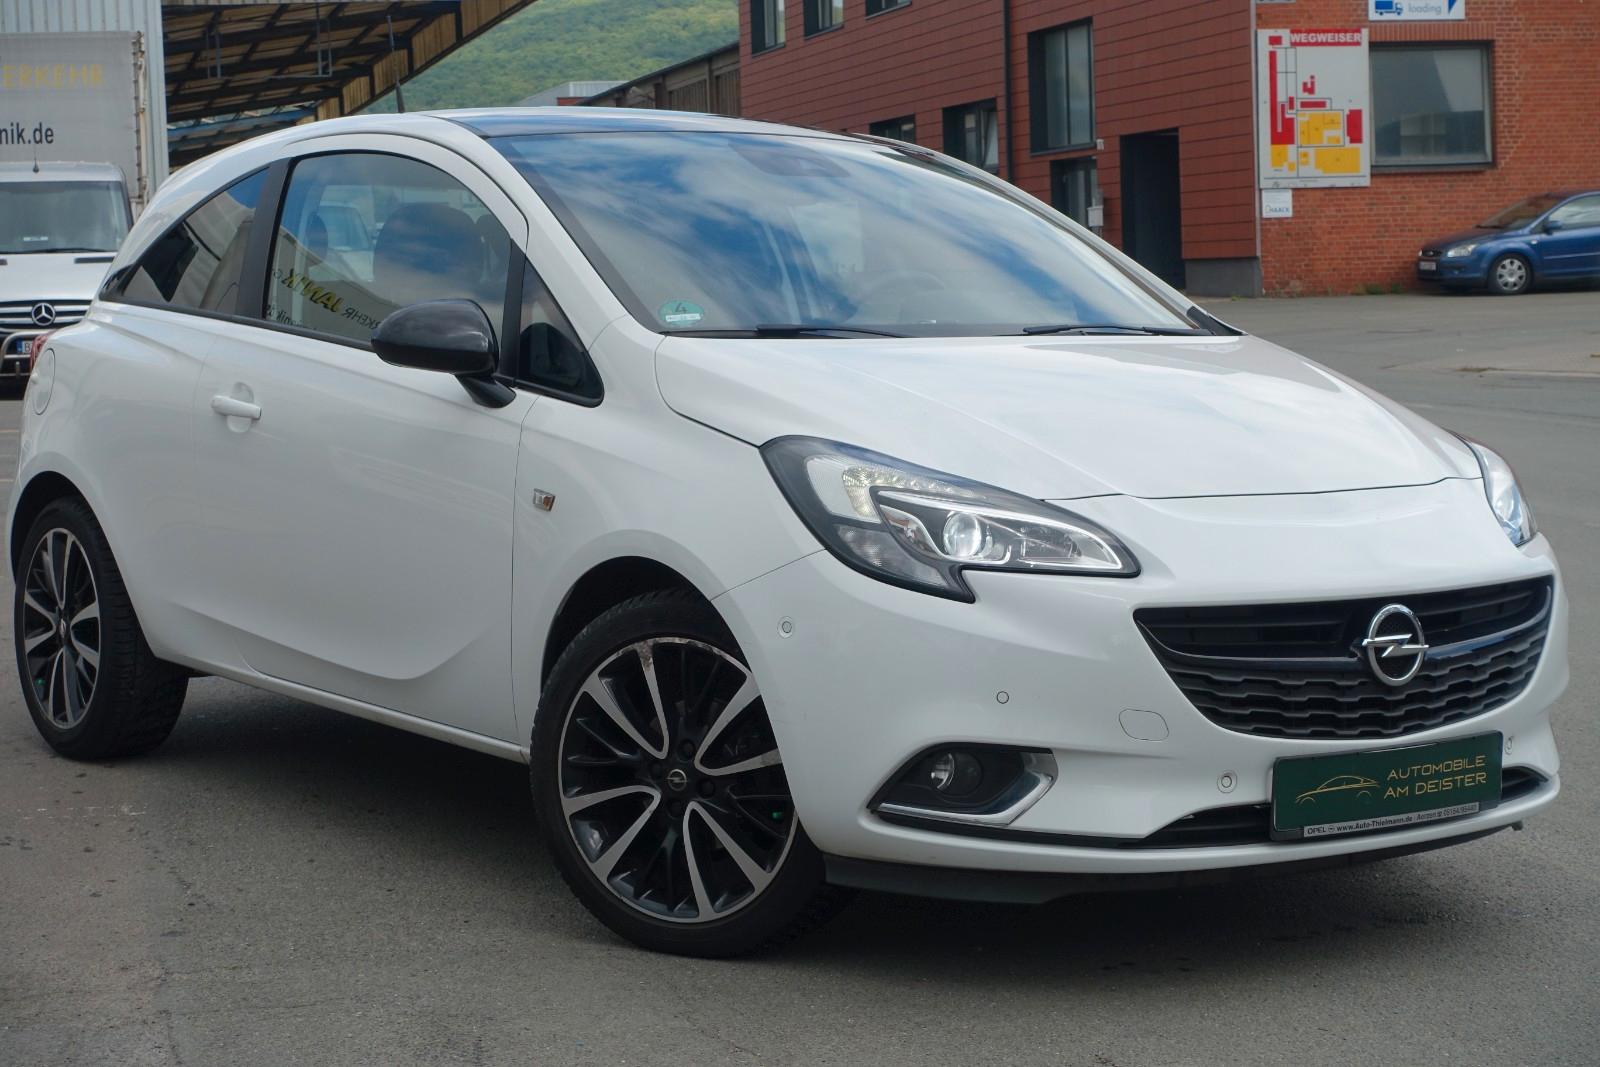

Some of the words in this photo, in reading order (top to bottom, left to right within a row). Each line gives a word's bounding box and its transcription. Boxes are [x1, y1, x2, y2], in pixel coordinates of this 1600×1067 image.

[1408, 2, 1442, 15] loading
[1290, 32, 1362, 43] WEGWEISER
[0, 122, 54, 145] nik.de
[1387, 755, 1486, 781] AUTOMOBILE
[1384, 785, 1408, 799] AM
[1415, 772, 1487, 795] DEISTER
[1307, 826, 1327, 835] OPEL
